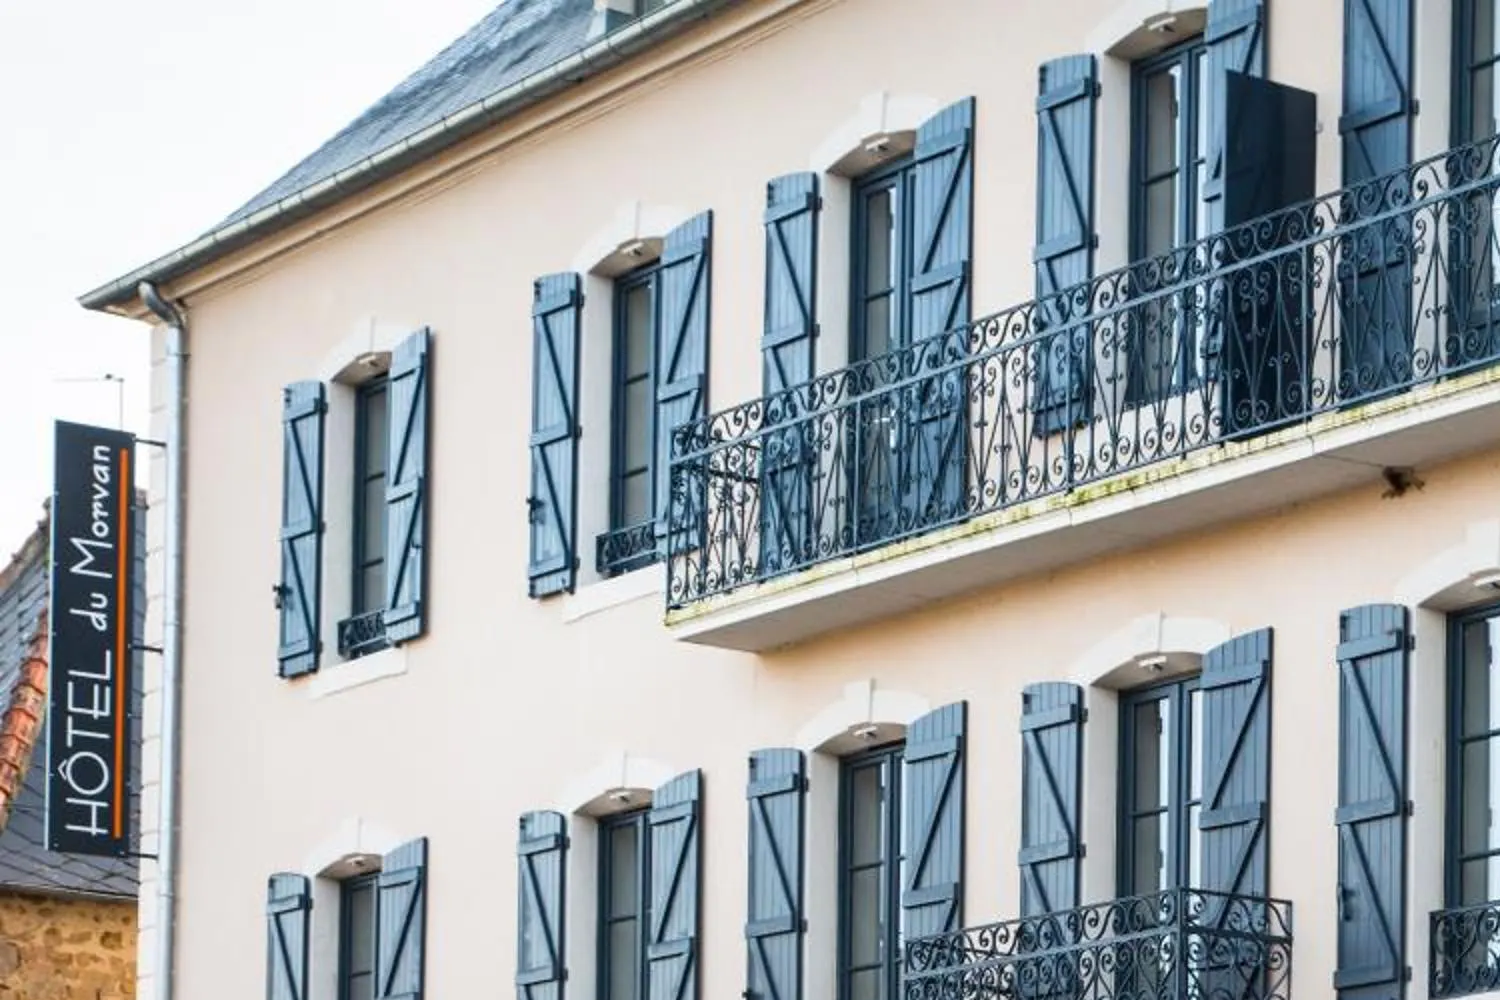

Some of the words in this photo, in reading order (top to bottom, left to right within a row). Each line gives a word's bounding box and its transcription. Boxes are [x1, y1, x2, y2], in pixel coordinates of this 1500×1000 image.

[69, 444, 113, 579] Morvan
[69, 592, 109, 632] du
[58, 649, 111, 836] HÔTEL
